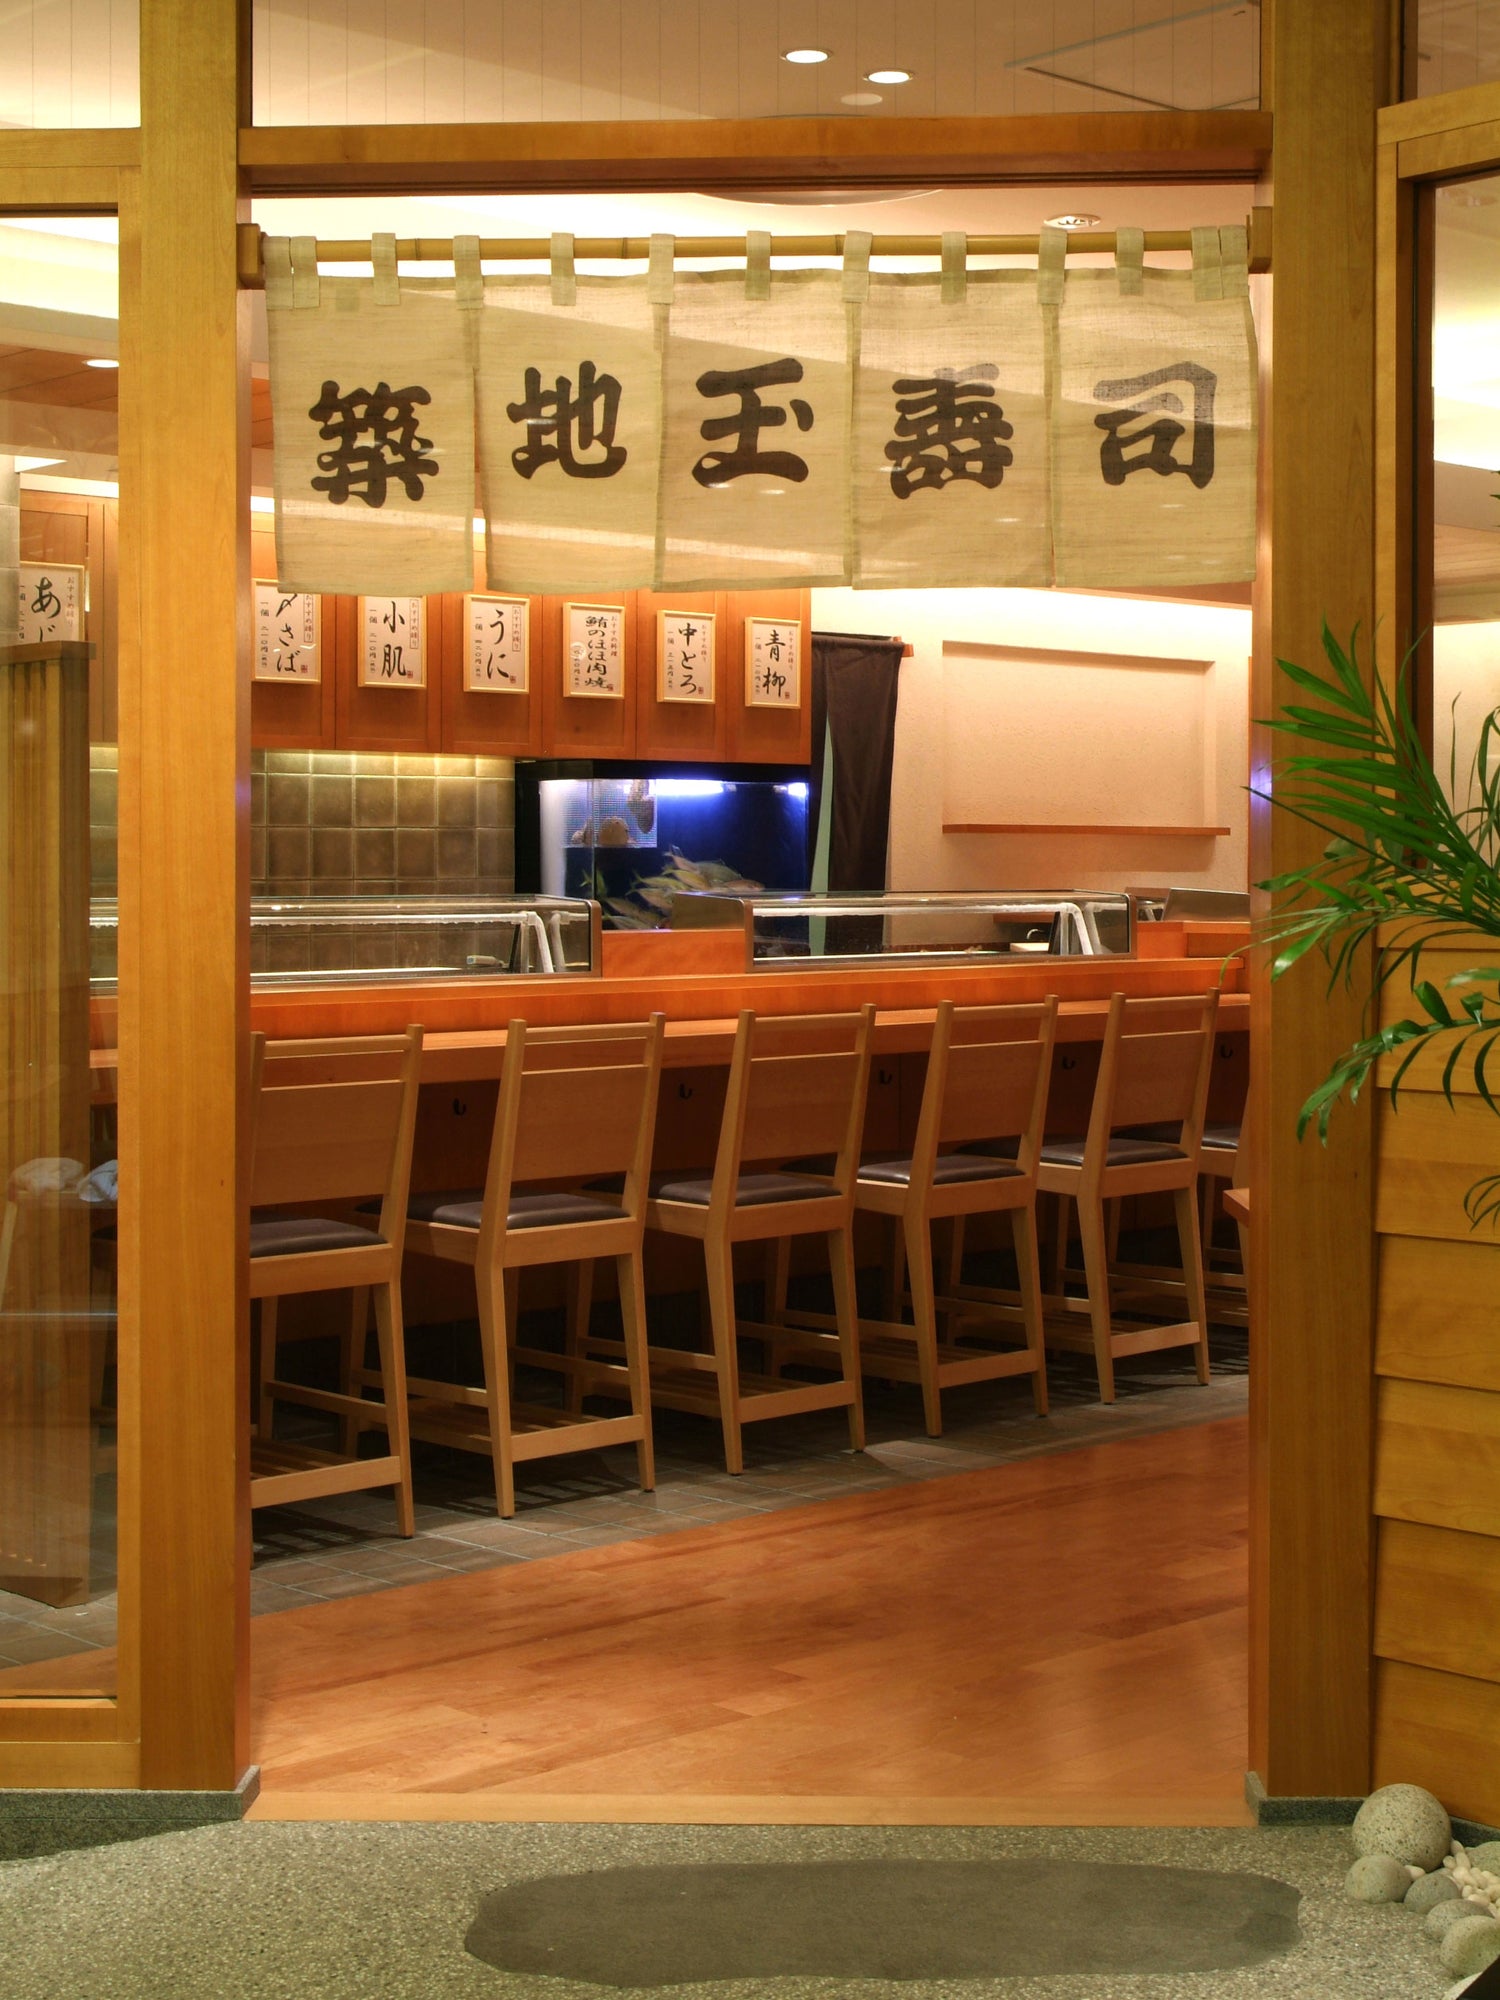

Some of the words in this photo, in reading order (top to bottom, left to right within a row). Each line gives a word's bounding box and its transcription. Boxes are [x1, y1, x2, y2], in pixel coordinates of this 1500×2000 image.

[381, 600, 407, 678] 小肌
[487, 609, 509, 679] うに
[678, 622, 698, 694] 中とろ
[762, 629, 786, 697] 青柳
